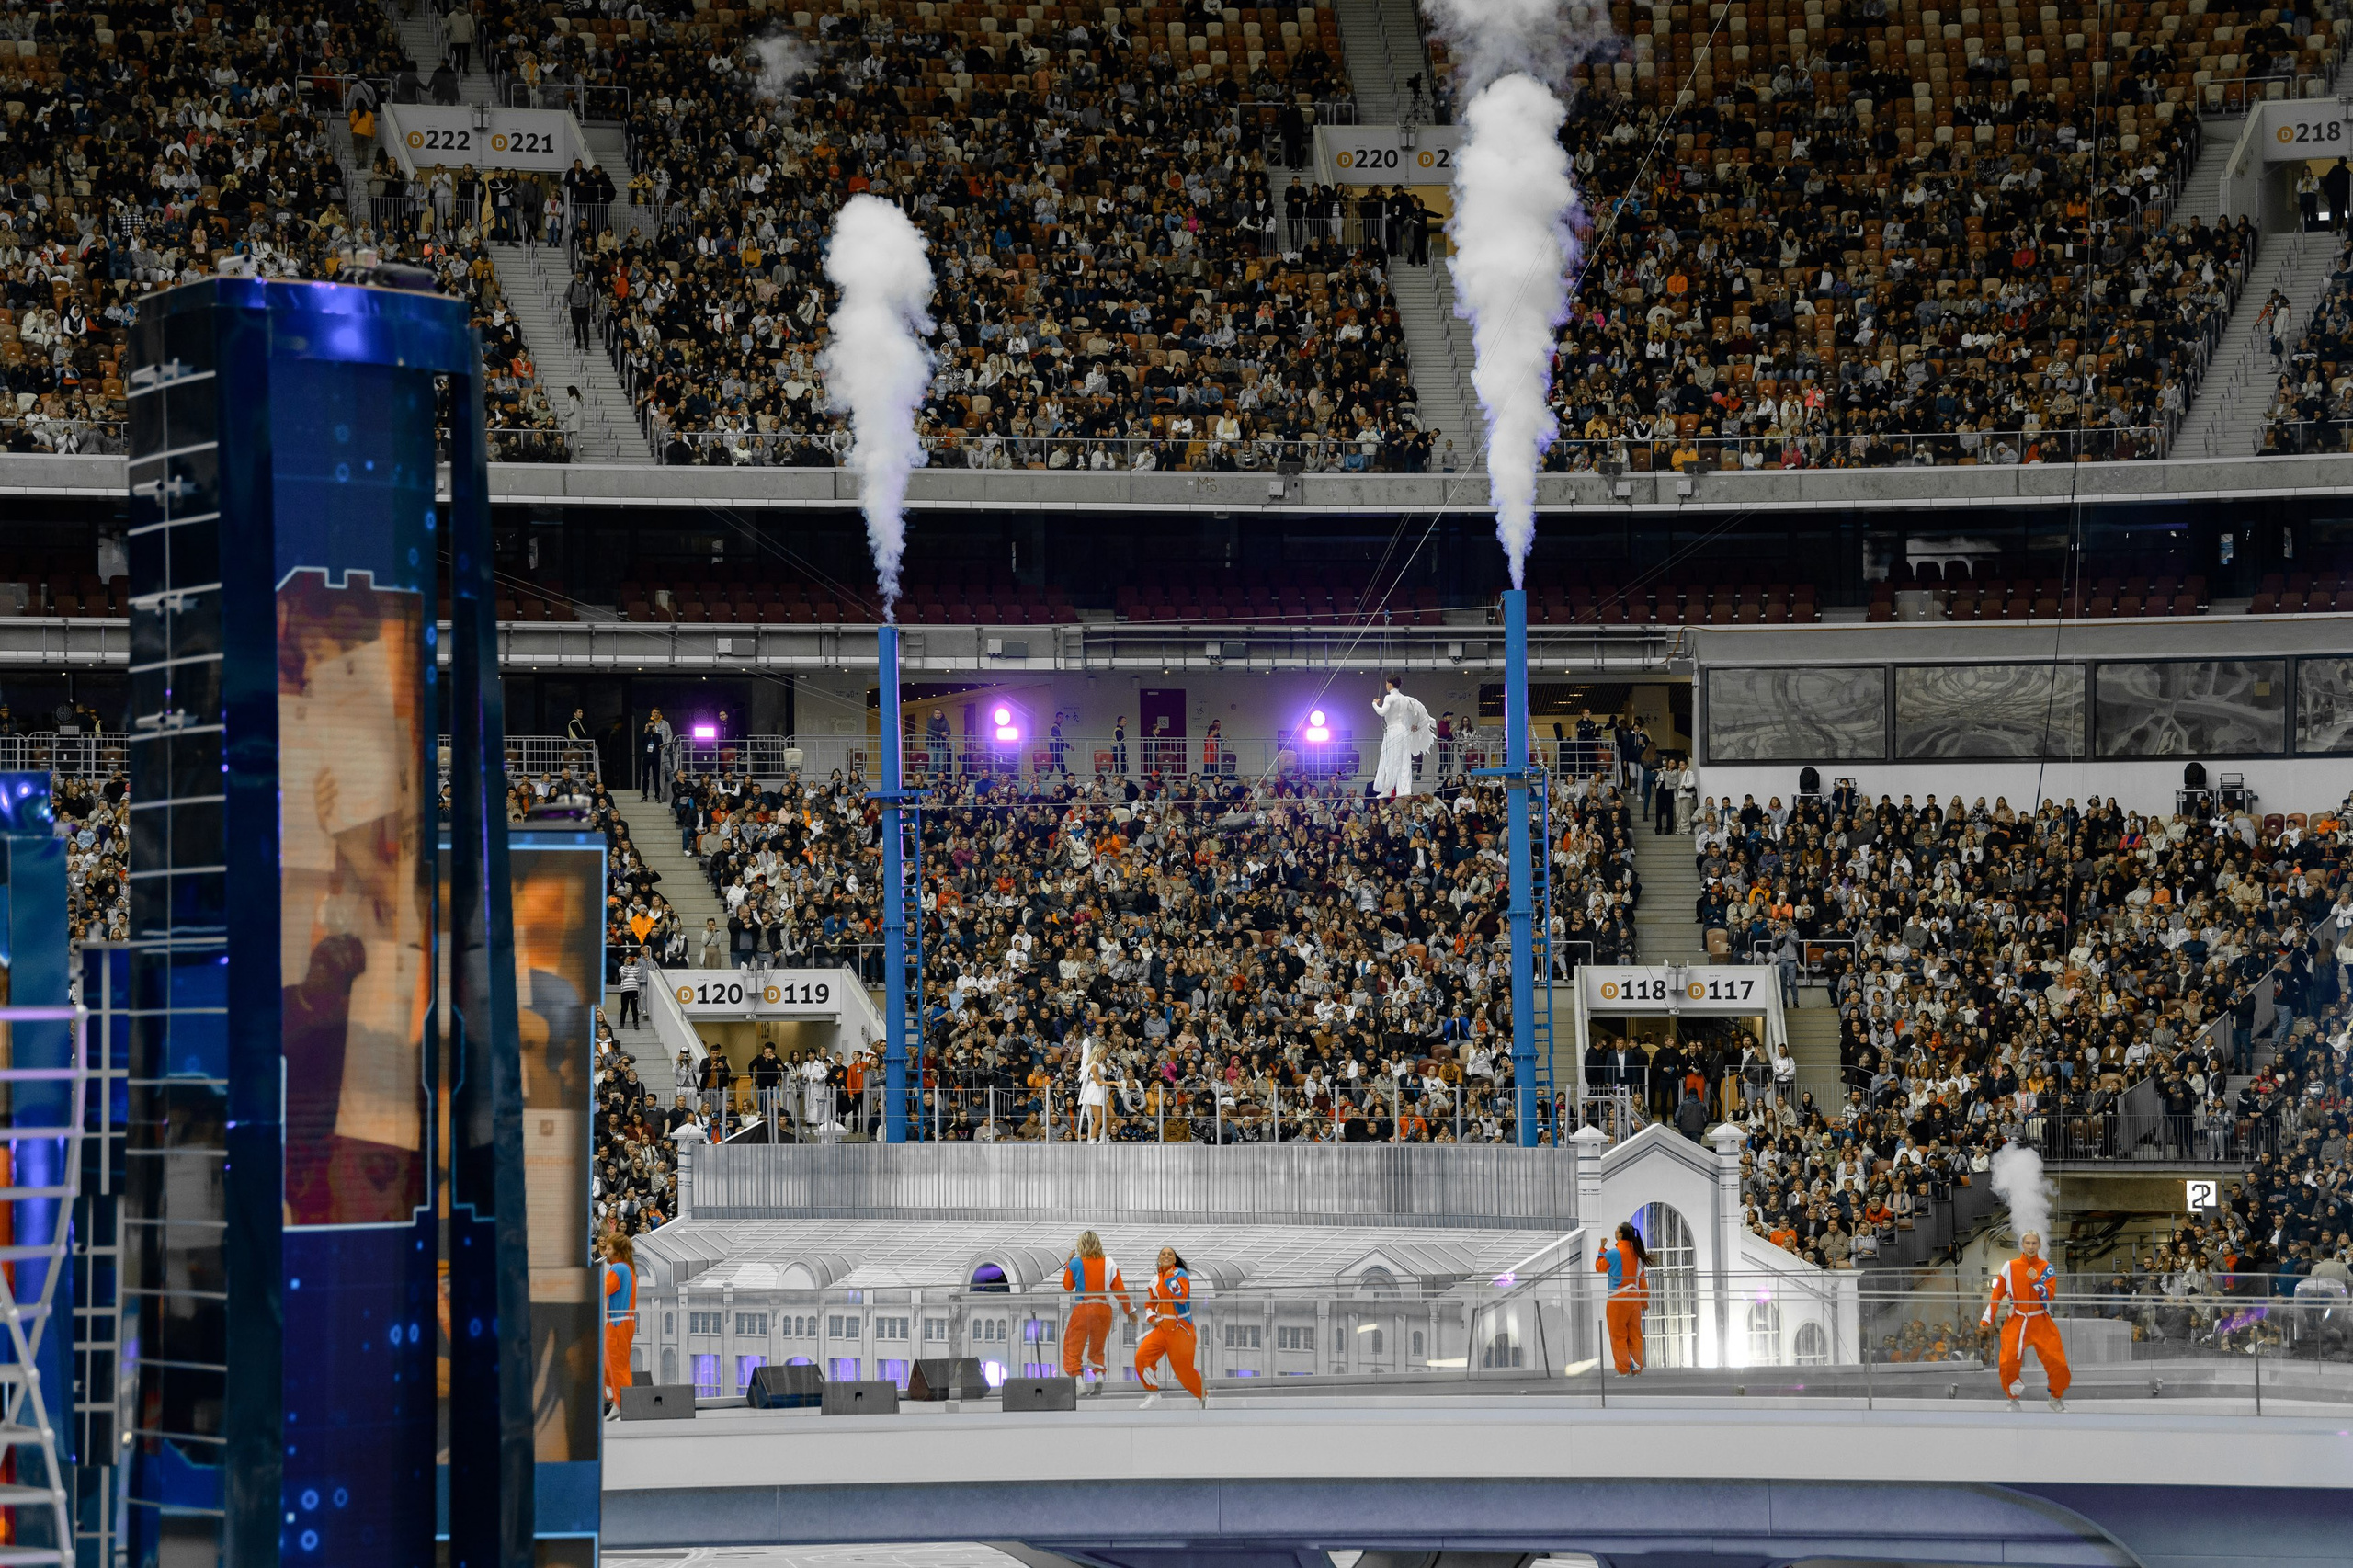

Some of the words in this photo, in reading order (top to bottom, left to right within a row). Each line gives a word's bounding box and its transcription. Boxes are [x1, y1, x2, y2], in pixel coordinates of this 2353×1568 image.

[426, 130, 470, 151] 222
[2296, 121, 2341, 142] 218
[511, 133, 554, 153] 221
[1355, 149, 1399, 168] 220
[698, 983, 743, 1004] 120
[785, 983, 829, 1004] 119
[1621, 980, 1666, 1000] 118
[1709, 980, 1755, 1000] 117
[2191, 1184, 2211, 1209] 2
